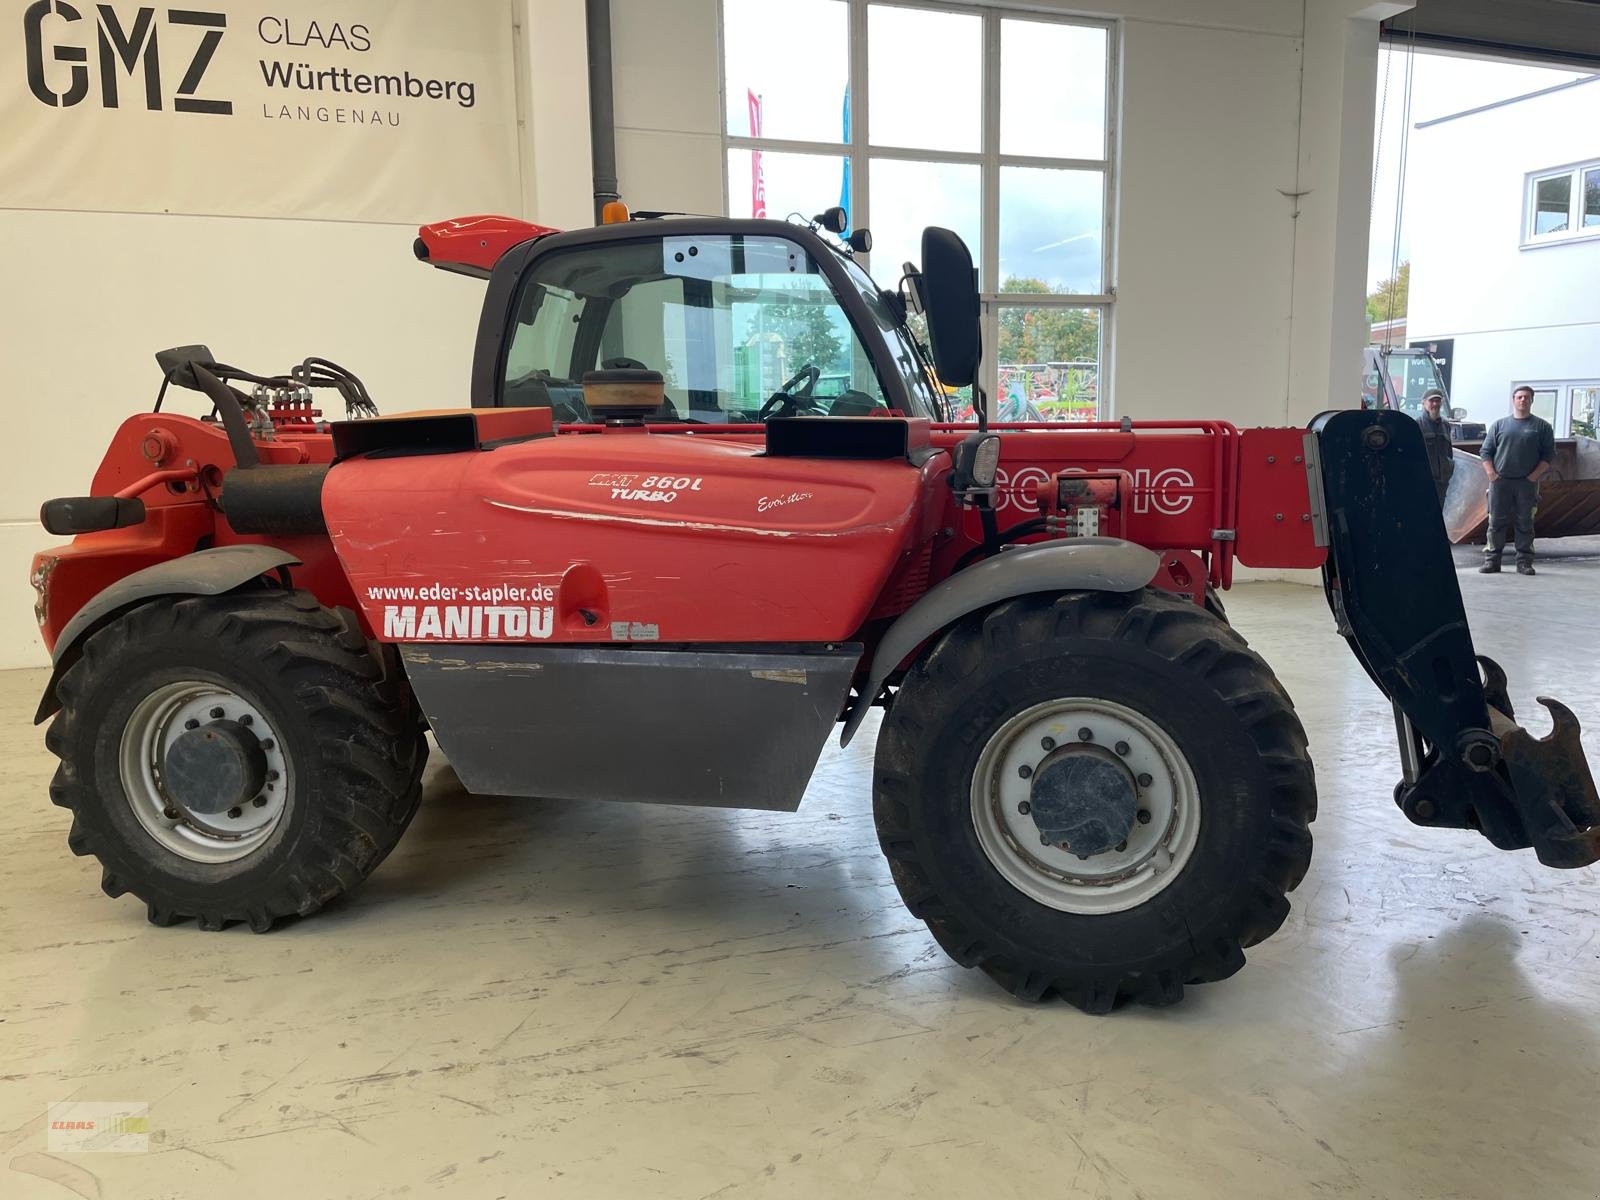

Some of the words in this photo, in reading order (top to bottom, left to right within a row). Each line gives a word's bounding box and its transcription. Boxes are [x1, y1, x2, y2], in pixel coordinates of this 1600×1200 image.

[257, 16, 371, 51] CLAAS
[23, 0, 233, 115] GMZ
[259, 59, 476, 108] Württemberg
[263, 103, 401, 127] LANGENAU
[610, 488, 678, 503] TURBO
[367, 583, 554, 605] www.eder-stapler.de
[384, 605, 554, 639] MANITOU
